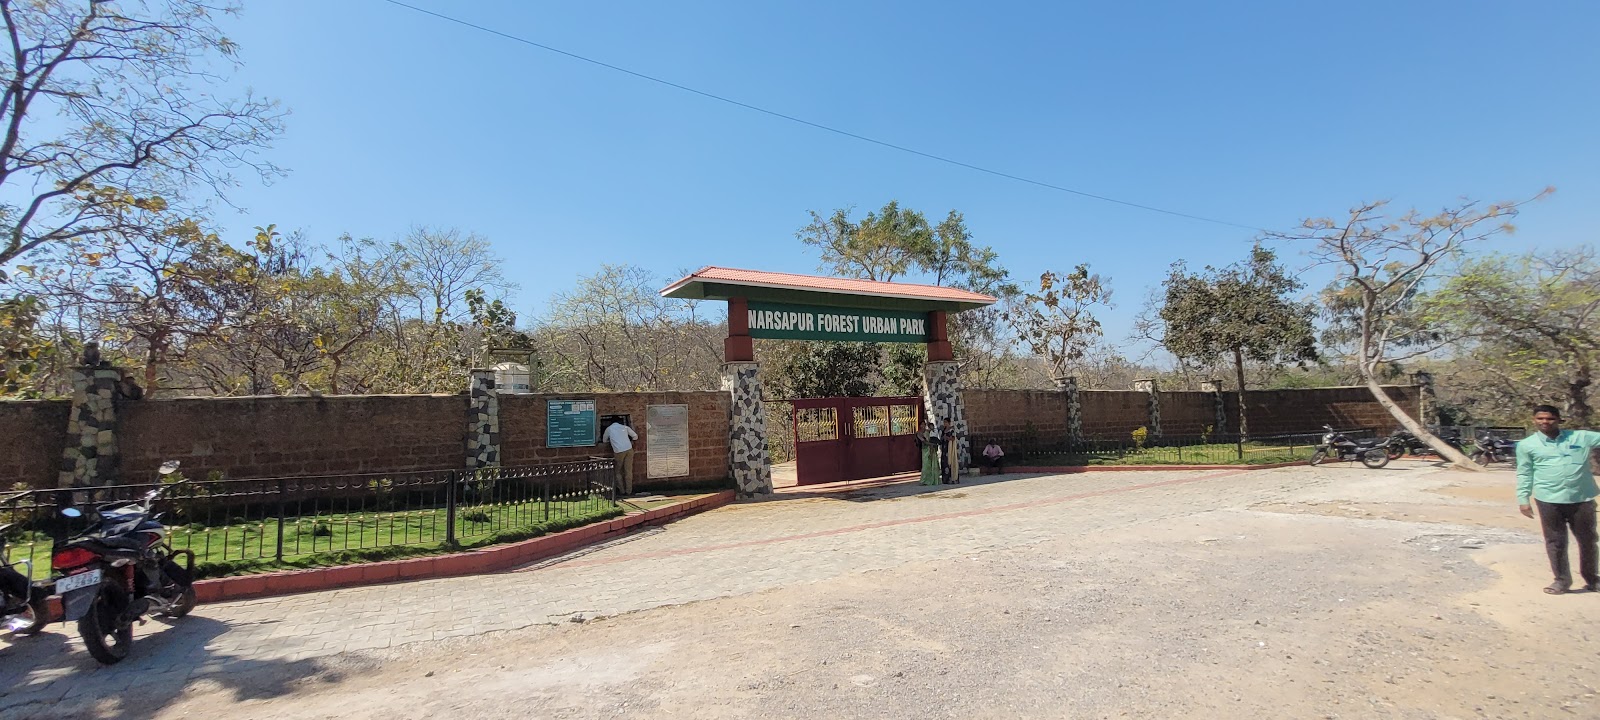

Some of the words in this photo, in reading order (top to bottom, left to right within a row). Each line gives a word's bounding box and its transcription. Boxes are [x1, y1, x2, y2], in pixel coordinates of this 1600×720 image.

[748, 309, 815, 332] NARSAPUR
[817, 313, 860, 334] FOREST
[862, 316, 898, 335] URBAN
[900, 318, 926, 336] PARK
